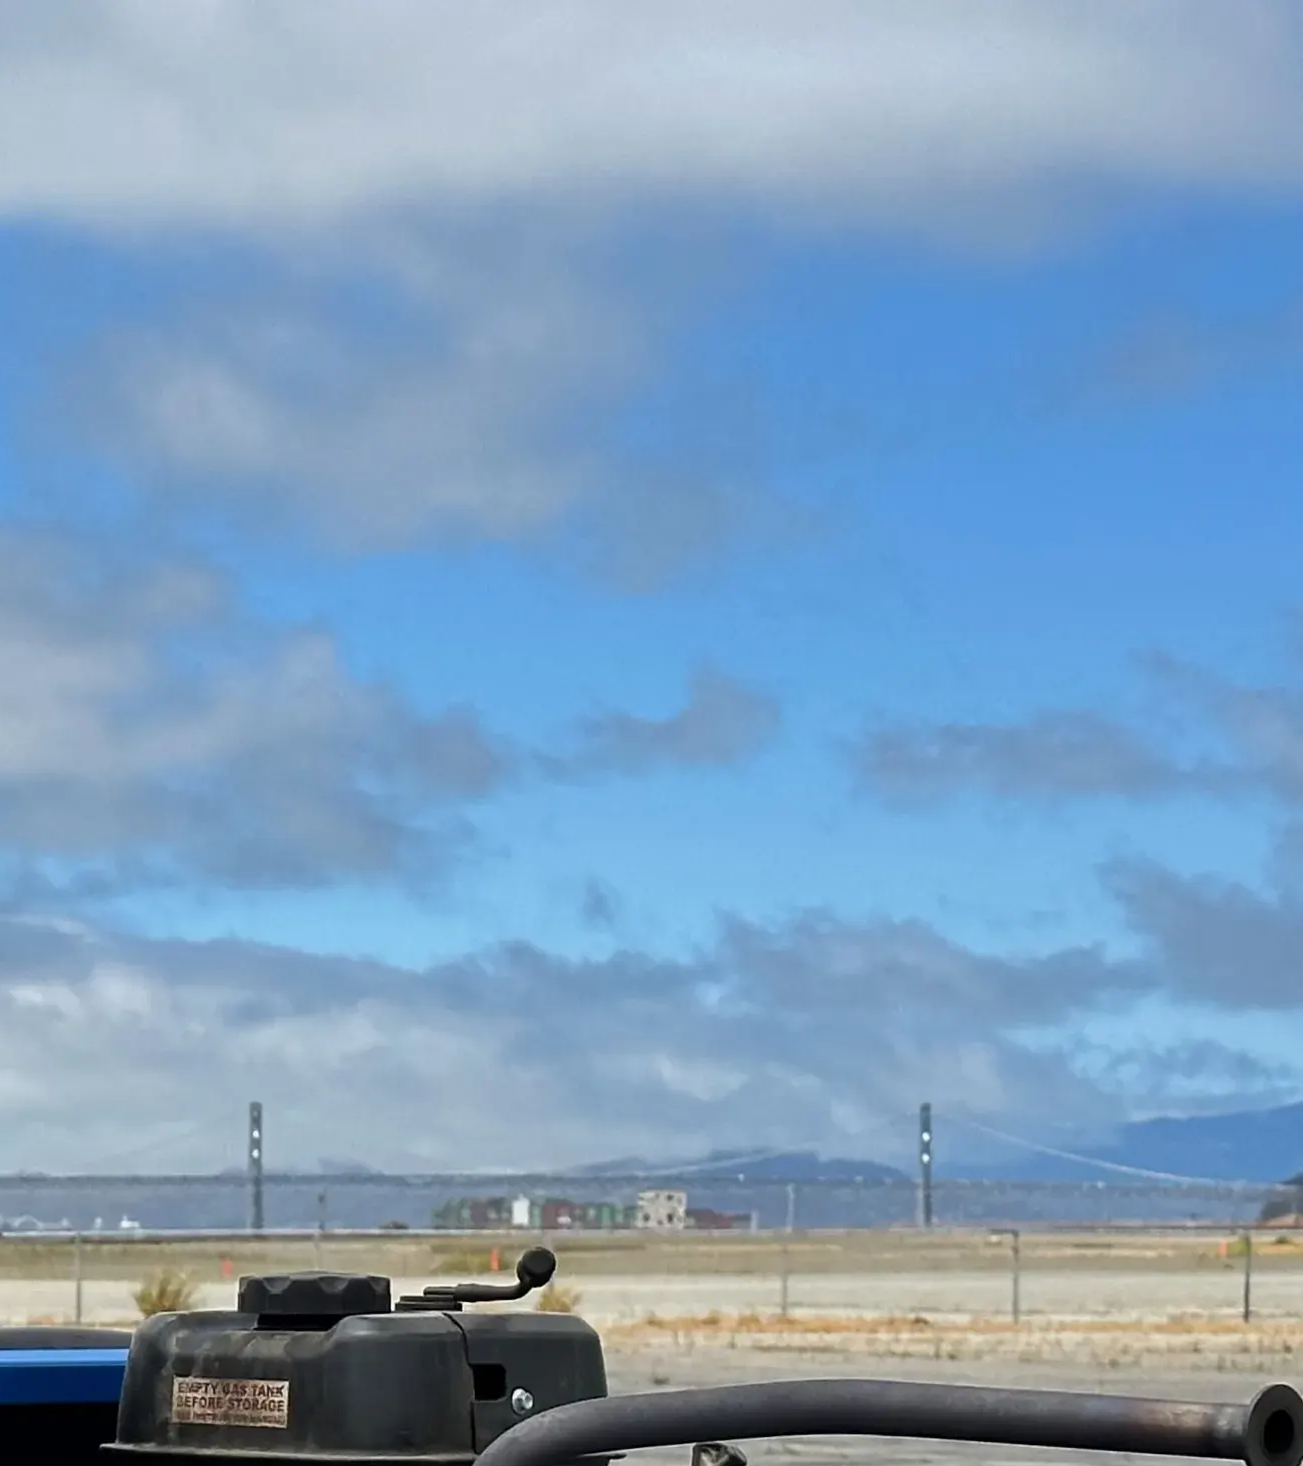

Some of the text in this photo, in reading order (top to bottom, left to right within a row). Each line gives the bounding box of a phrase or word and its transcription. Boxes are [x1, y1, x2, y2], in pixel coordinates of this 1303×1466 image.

[178, 1382, 284, 1398] EMPTY GAS TANK
[176, 1395, 285, 1412] BEFORE STORAGE
